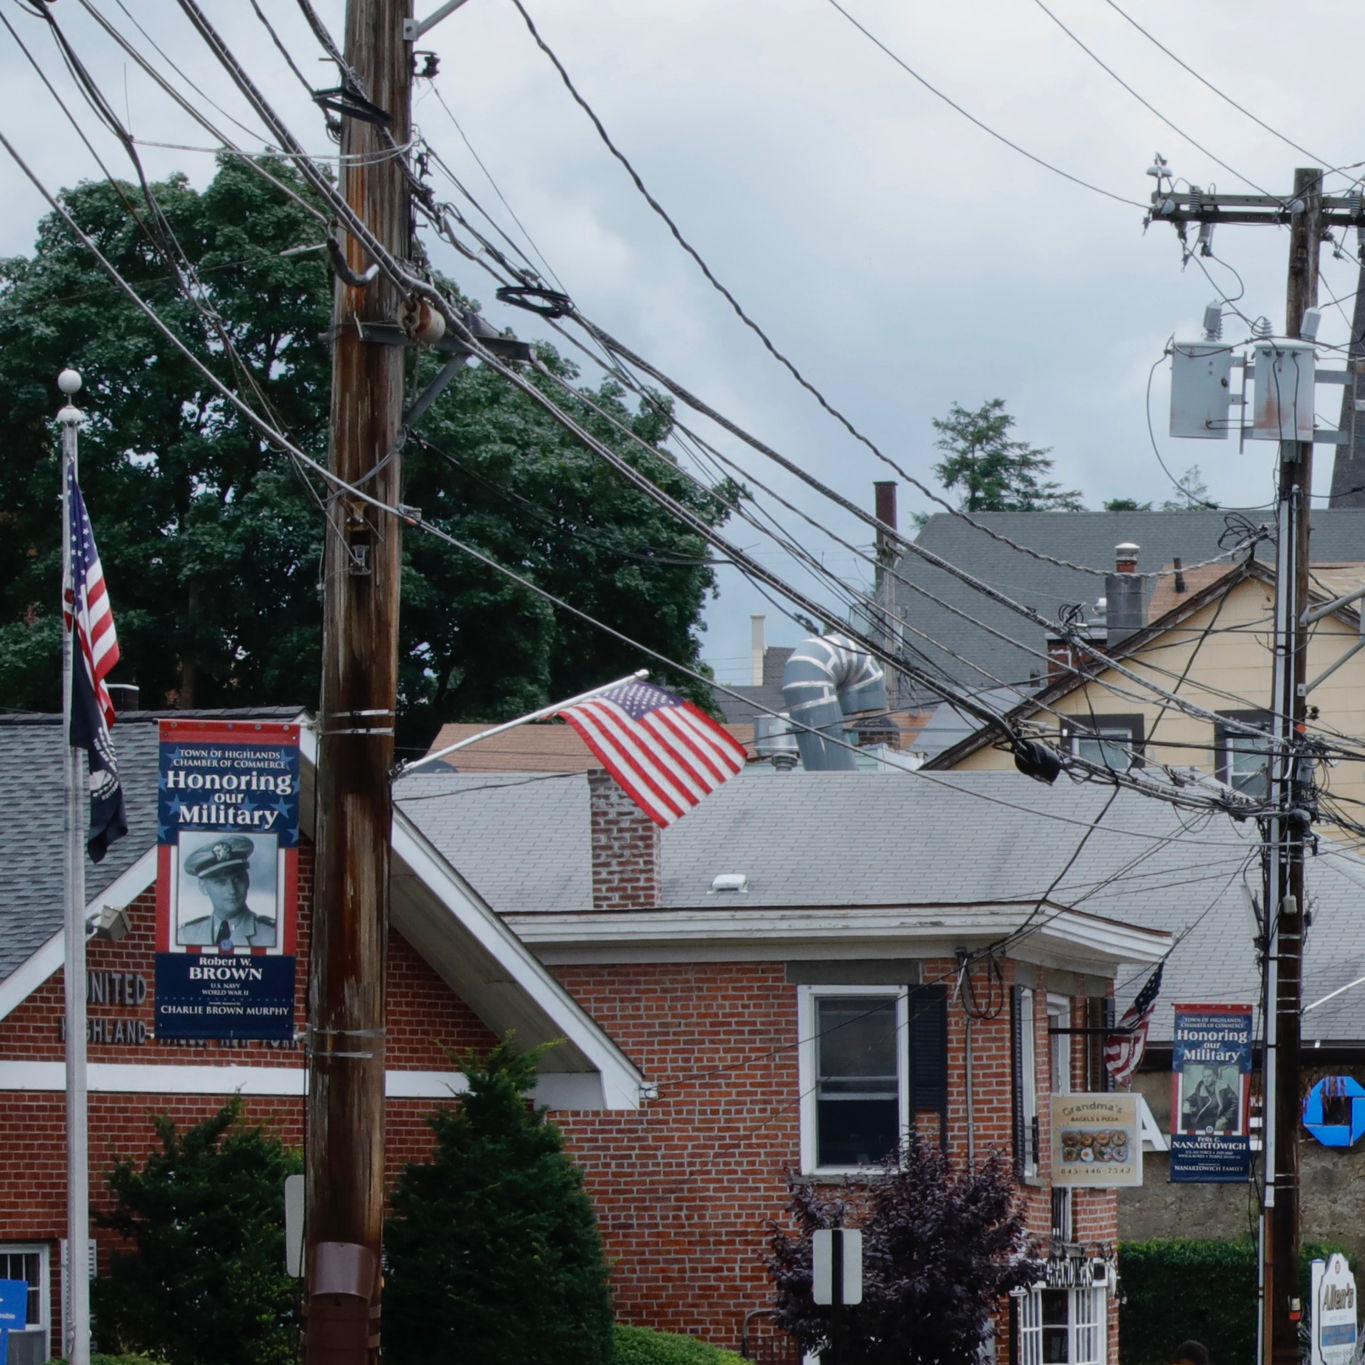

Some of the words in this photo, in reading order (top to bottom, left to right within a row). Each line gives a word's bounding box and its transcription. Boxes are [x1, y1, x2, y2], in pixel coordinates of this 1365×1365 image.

[180, 749, 208, 758] TOWN
[210, 750, 223, 759] OF
[225, 750, 280, 760] HIGHLANDS
[173, 758, 219, 768] CHAMBER
[220, 760, 232, 768] OF
[234, 759, 286, 769] COMMERCE
[167, 770, 292, 795] Honoring
[214, 792, 244, 804] our
[178, 804, 279, 829] Military
[199, 957, 237, 967] Robert
[240, 958, 252, 967] W.
[189, 966, 263, 980] BROWN
[160, 1005, 204, 1015] CHARLIE
[206, 1006, 244, 1015] BROWN
[246, 1007, 289, 1016] MURPHY
[1177, 1029, 1248, 1043] Honoring
[1183, 1049, 1240, 1062] Military
[1062, 1101, 1124, 1116] Grandma's
[1172, 1141, 1246, 1150] NANARTOWICH
[1322, 1282, 1355, 1311] Allen's
